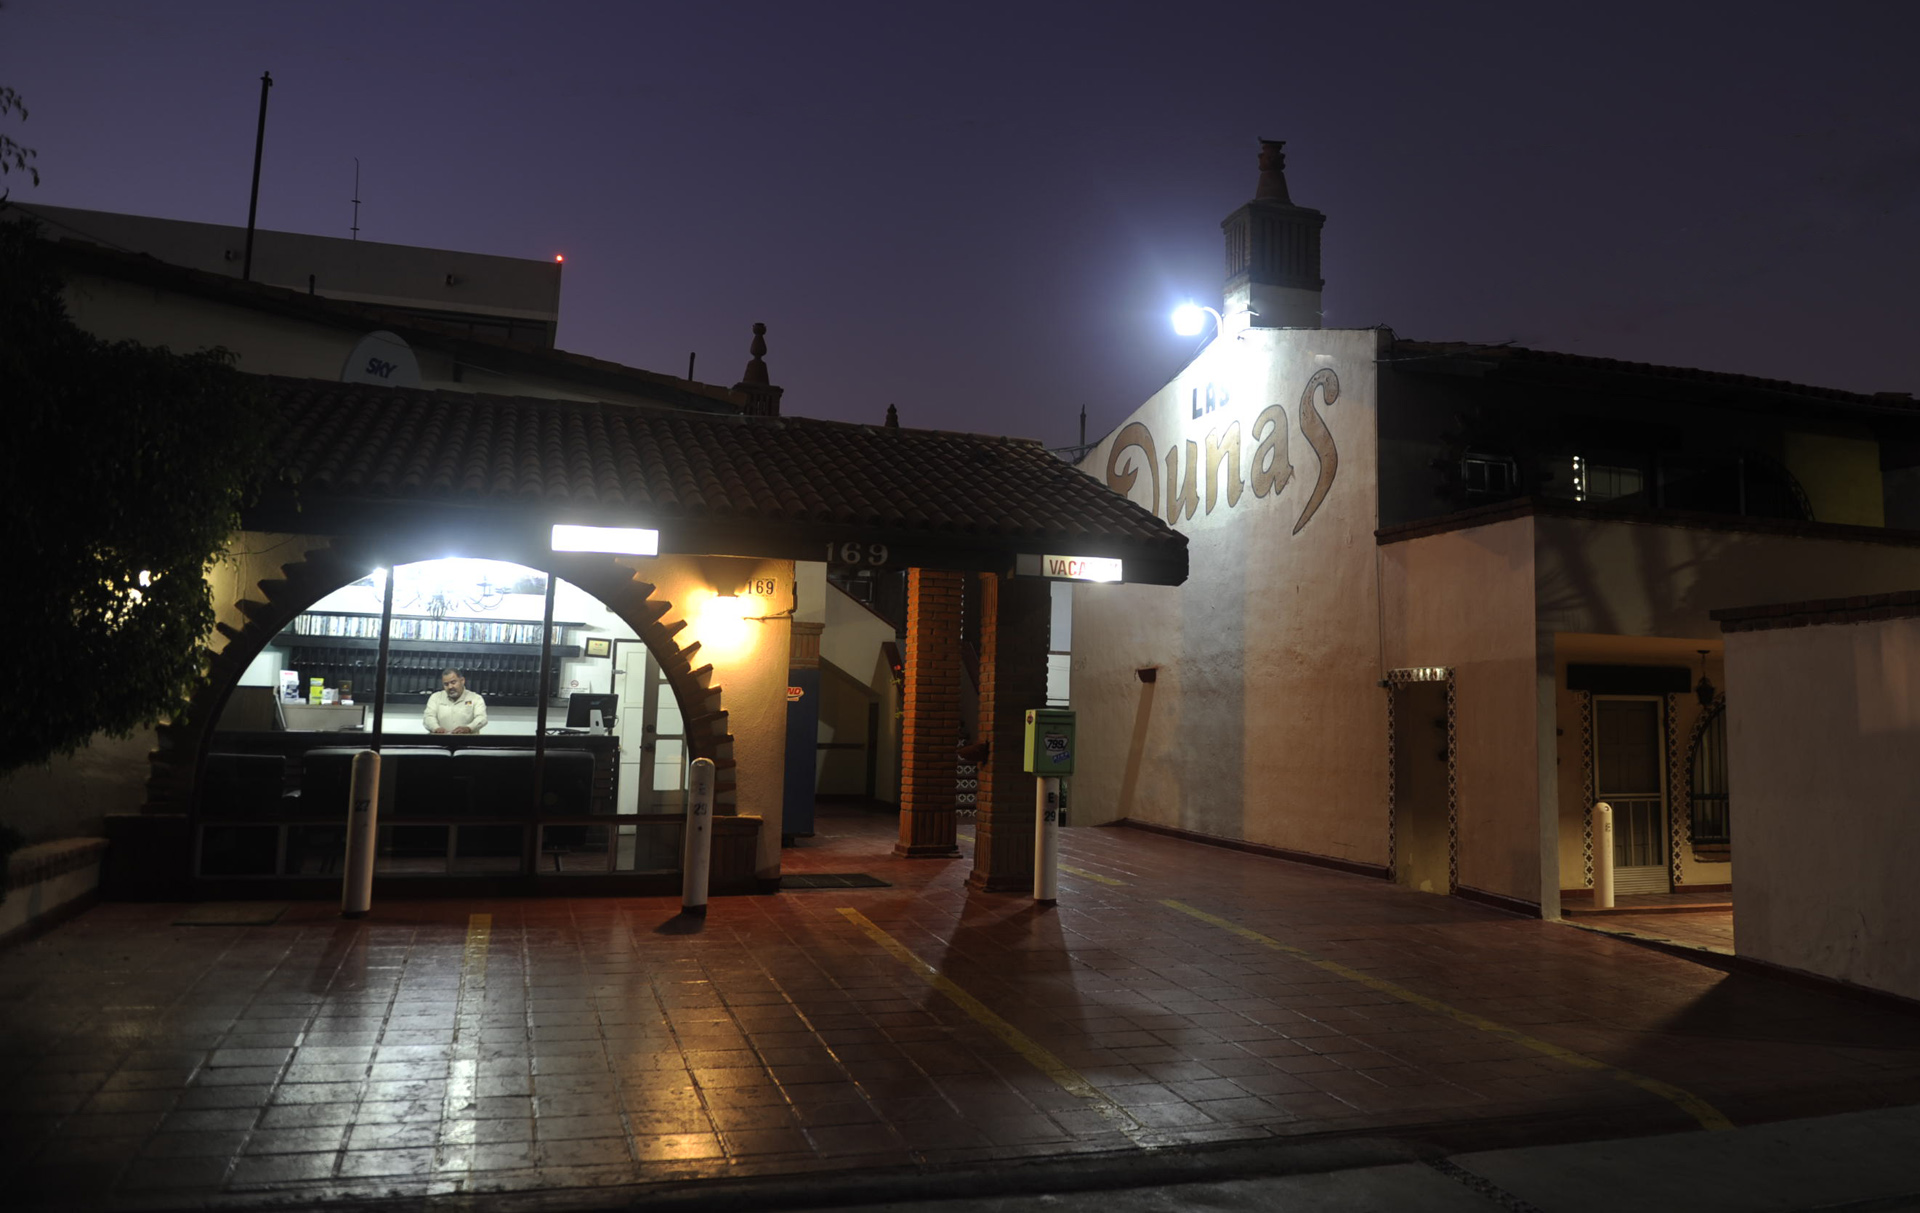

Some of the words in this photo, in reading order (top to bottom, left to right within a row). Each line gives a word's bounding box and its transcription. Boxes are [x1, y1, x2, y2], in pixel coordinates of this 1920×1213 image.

[366, 357, 398, 378] SKY
[826, 541, 888, 566] 169
[748, 580, 774, 595] 169
[1048, 792, 1054, 803] E
[1044, 811, 1056, 822] 29
